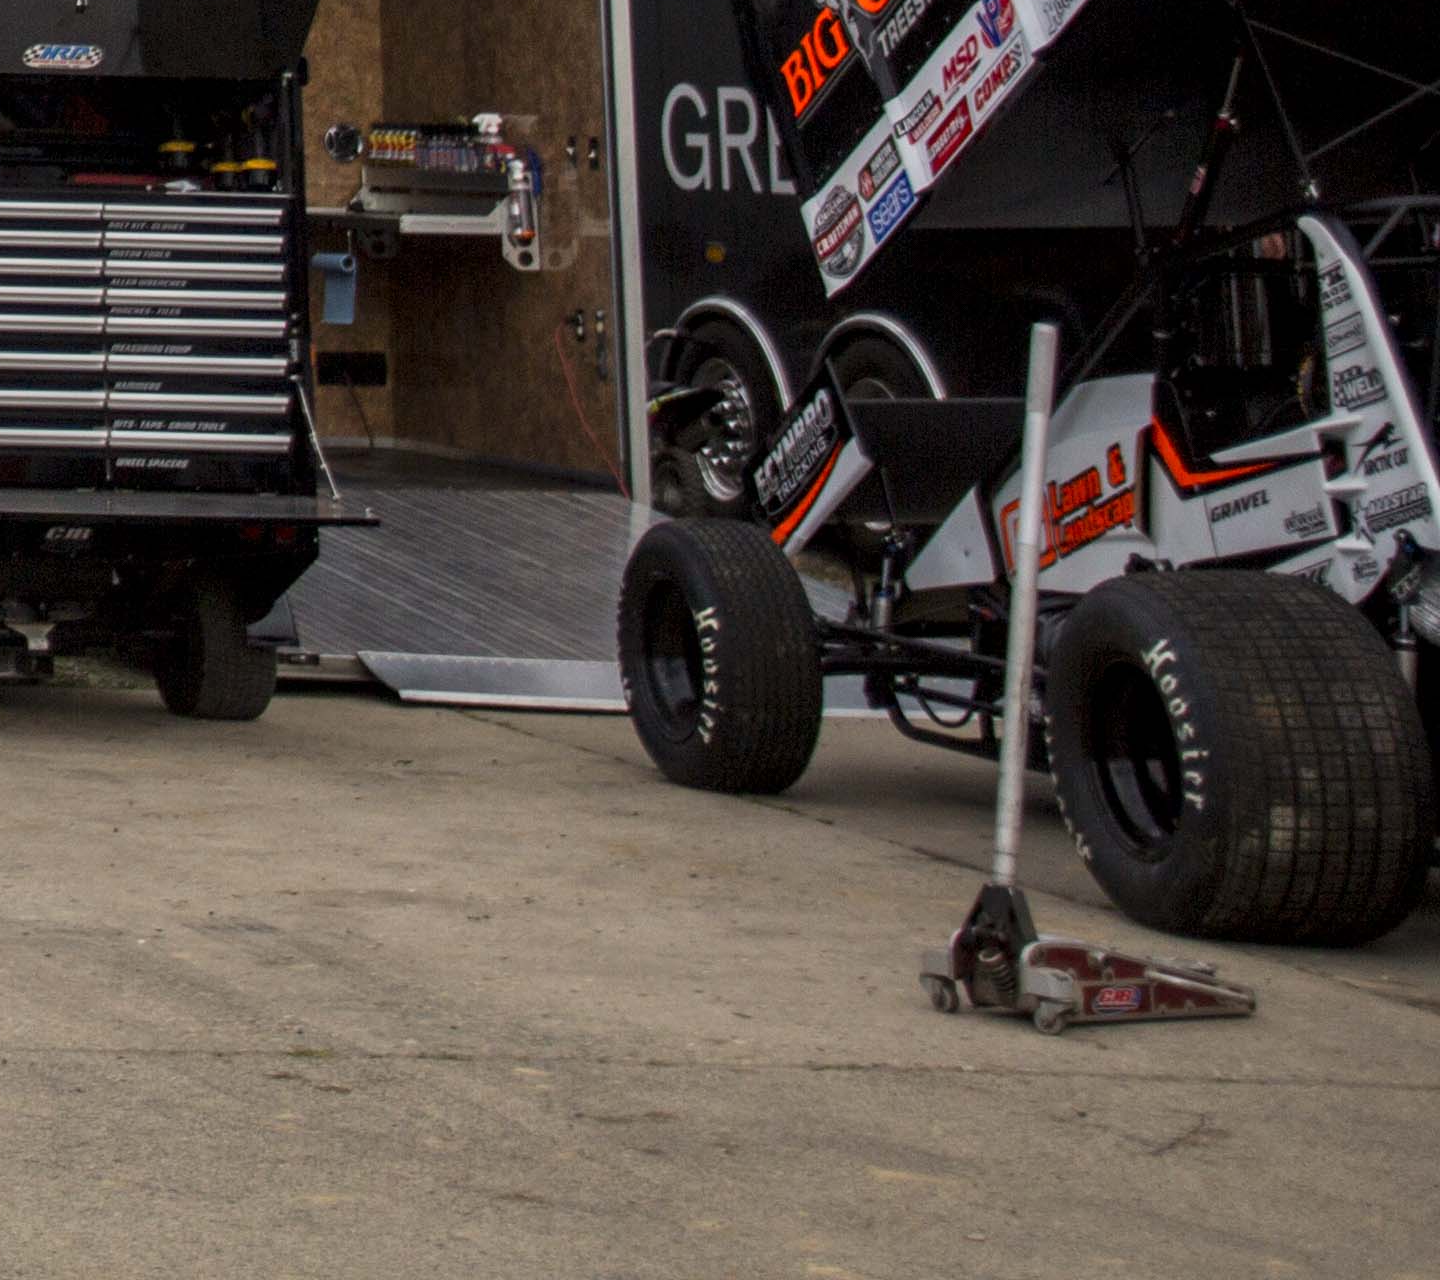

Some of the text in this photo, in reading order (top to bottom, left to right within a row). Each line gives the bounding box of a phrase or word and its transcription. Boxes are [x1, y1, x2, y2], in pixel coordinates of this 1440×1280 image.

[781, 7, 850, 117] BIG
[940, 34, 978, 93] MSD
[974, 53, 1013, 112] COMP
[1210, 489, 1271, 525] GRAVEL
[1141, 639, 1211, 813] Hoosier
